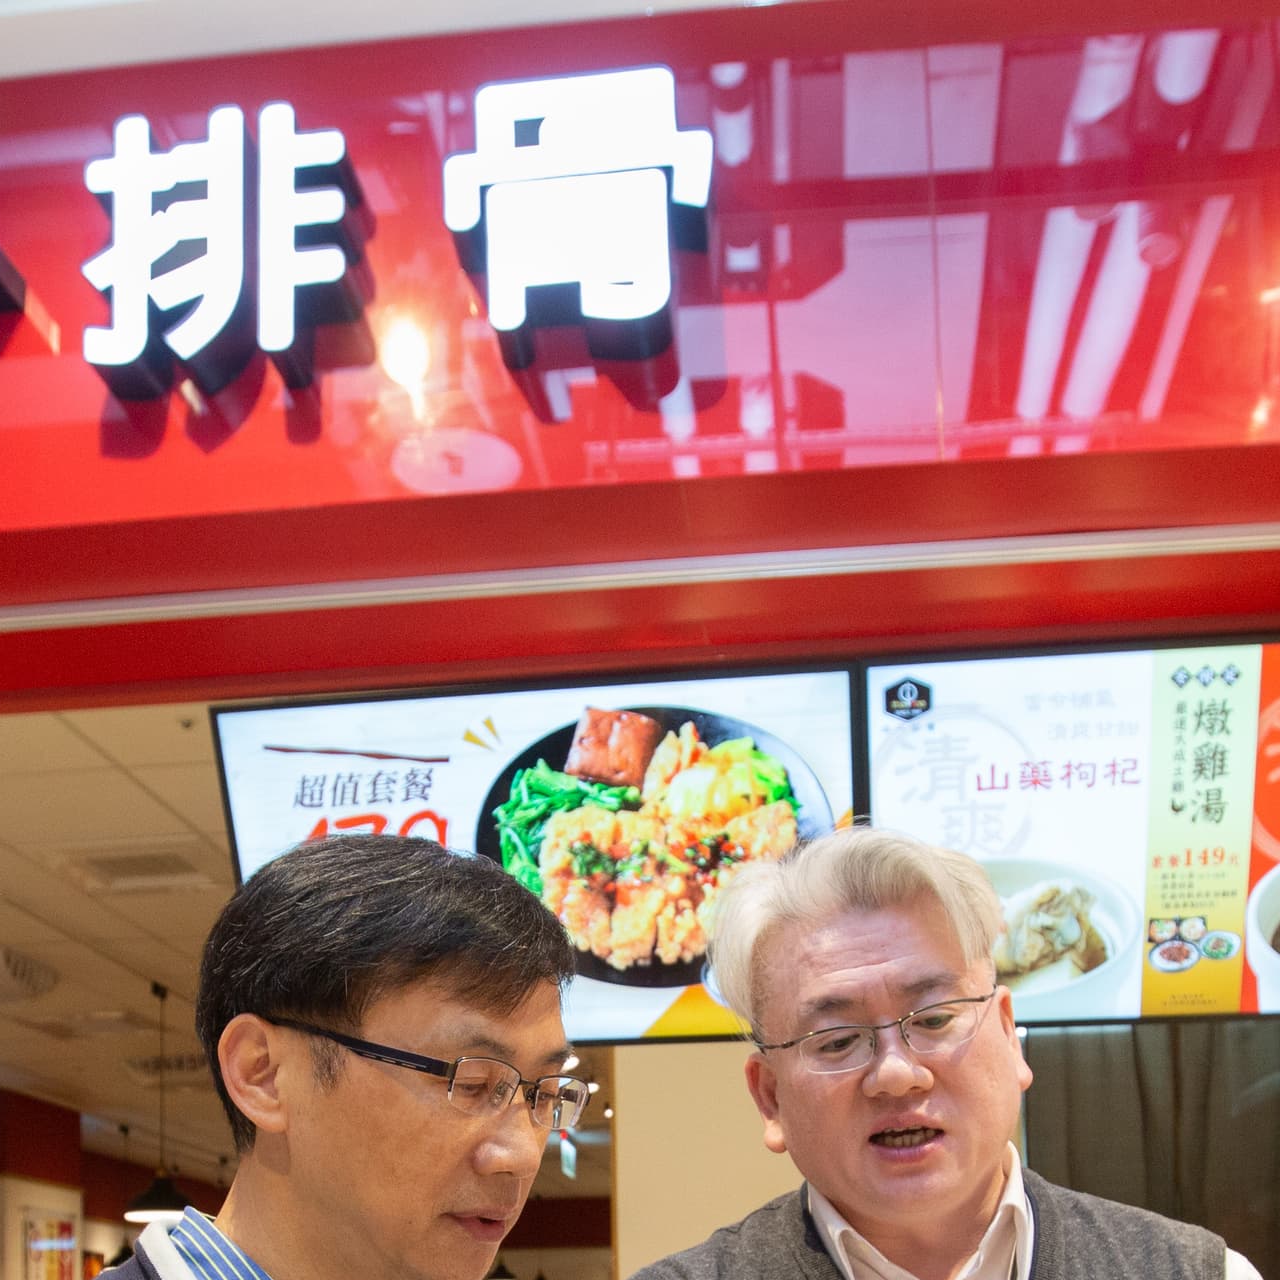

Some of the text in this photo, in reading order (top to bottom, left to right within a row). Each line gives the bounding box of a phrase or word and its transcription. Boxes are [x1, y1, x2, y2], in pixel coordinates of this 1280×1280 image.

[976, 758, 1141, 792] 山藥枸杞
[1192, 698, 1233, 824] 燉雞湯
[293, 767, 433, 808] 超值套餐
